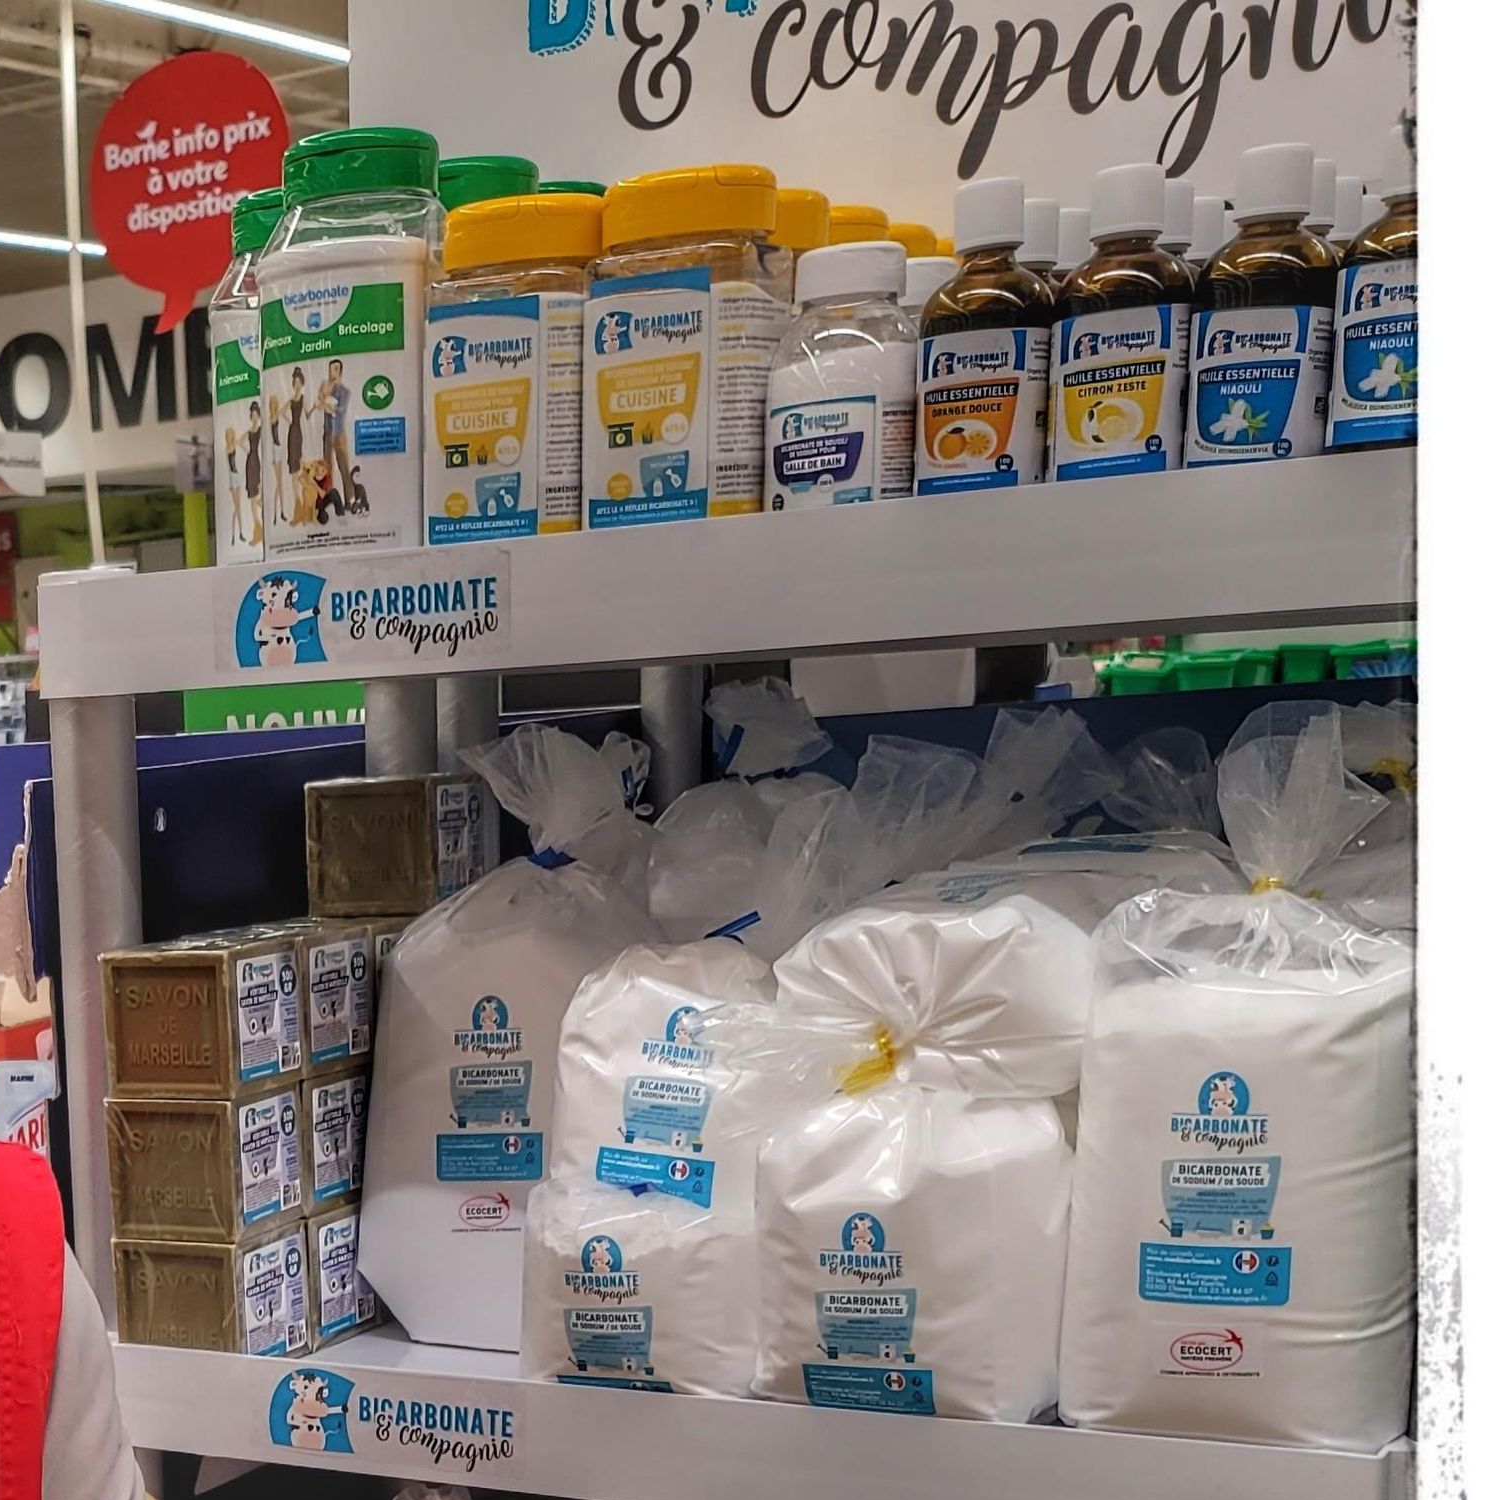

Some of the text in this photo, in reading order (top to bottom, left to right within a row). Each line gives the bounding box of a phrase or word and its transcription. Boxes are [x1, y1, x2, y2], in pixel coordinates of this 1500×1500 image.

[104, 112, 271, 171] Borne info prix
[147, 161, 228, 195] à votre
[300, 321, 394, 354] Jardin Bricolage
[1345, 319, 1418, 339] HUILE ESSENT
[1369, 337, 1414, 351] NIAOULI
[1065, 363, 1163, 386] HUILE ESSENTIELLE
[1200, 367, 1295, 382] HUILE ESSENTIELLE
[925, 385, 1016, 403] HUILE ESSENTIELLE
[1078, 380, 1147, 398] CITRON ZESTE
[1220, 383, 1262, 396] NIAOULI
[616, 388, 678, 410] CUISINE
[932, 403, 1002, 418] ORANGE DOUCE
[452, 411, 510, 431] CUISINE
[784, 457, 843, 473] SALLE DE BAIN
[331, 577, 497, 622] BICARBONATE
[376, 610, 498, 656] compagnie
[126, 985, 211, 1009] SAVON
[128, 1042, 212, 1067] MARSEILLE
[462, 1068, 520, 1079] BICARBONATE
[639, 1080, 701, 1097] BICARBONATE
[1171, 1117, 1268, 1133] BICARBONATE
[130, 1130, 213, 1150] SAVON
[1195, 1131, 1268, 1154] compagnie
[1179, 1164, 1262, 1177] BICARBONATE
[1172, 1176, 1181, 1184] DE
[1183, 1176, 1216, 1186] SODIUM
[1236, 1177, 1265, 1186] SOUDE
[133, 1187, 214, 1209] MARSEILLE
[465, 1207, 503, 1217] ECOCERT
[820, 1253, 903, 1269] BICARBONATE
[136, 1275, 218, 1291] SAVON
[565, 1274, 639, 1288] BICARBONATE
[829, 1295, 900, 1307] BICARBONATE
[575, 1312, 639, 1324] BICARBONATE
[834, 1306, 904, 1315] SODIUM SOUDE
[1180, 1346, 1232, 1357] ECOCERT
[359, 1396, 513, 1438] BICARBONATE
[399, 1424, 514, 1473] compagnie
